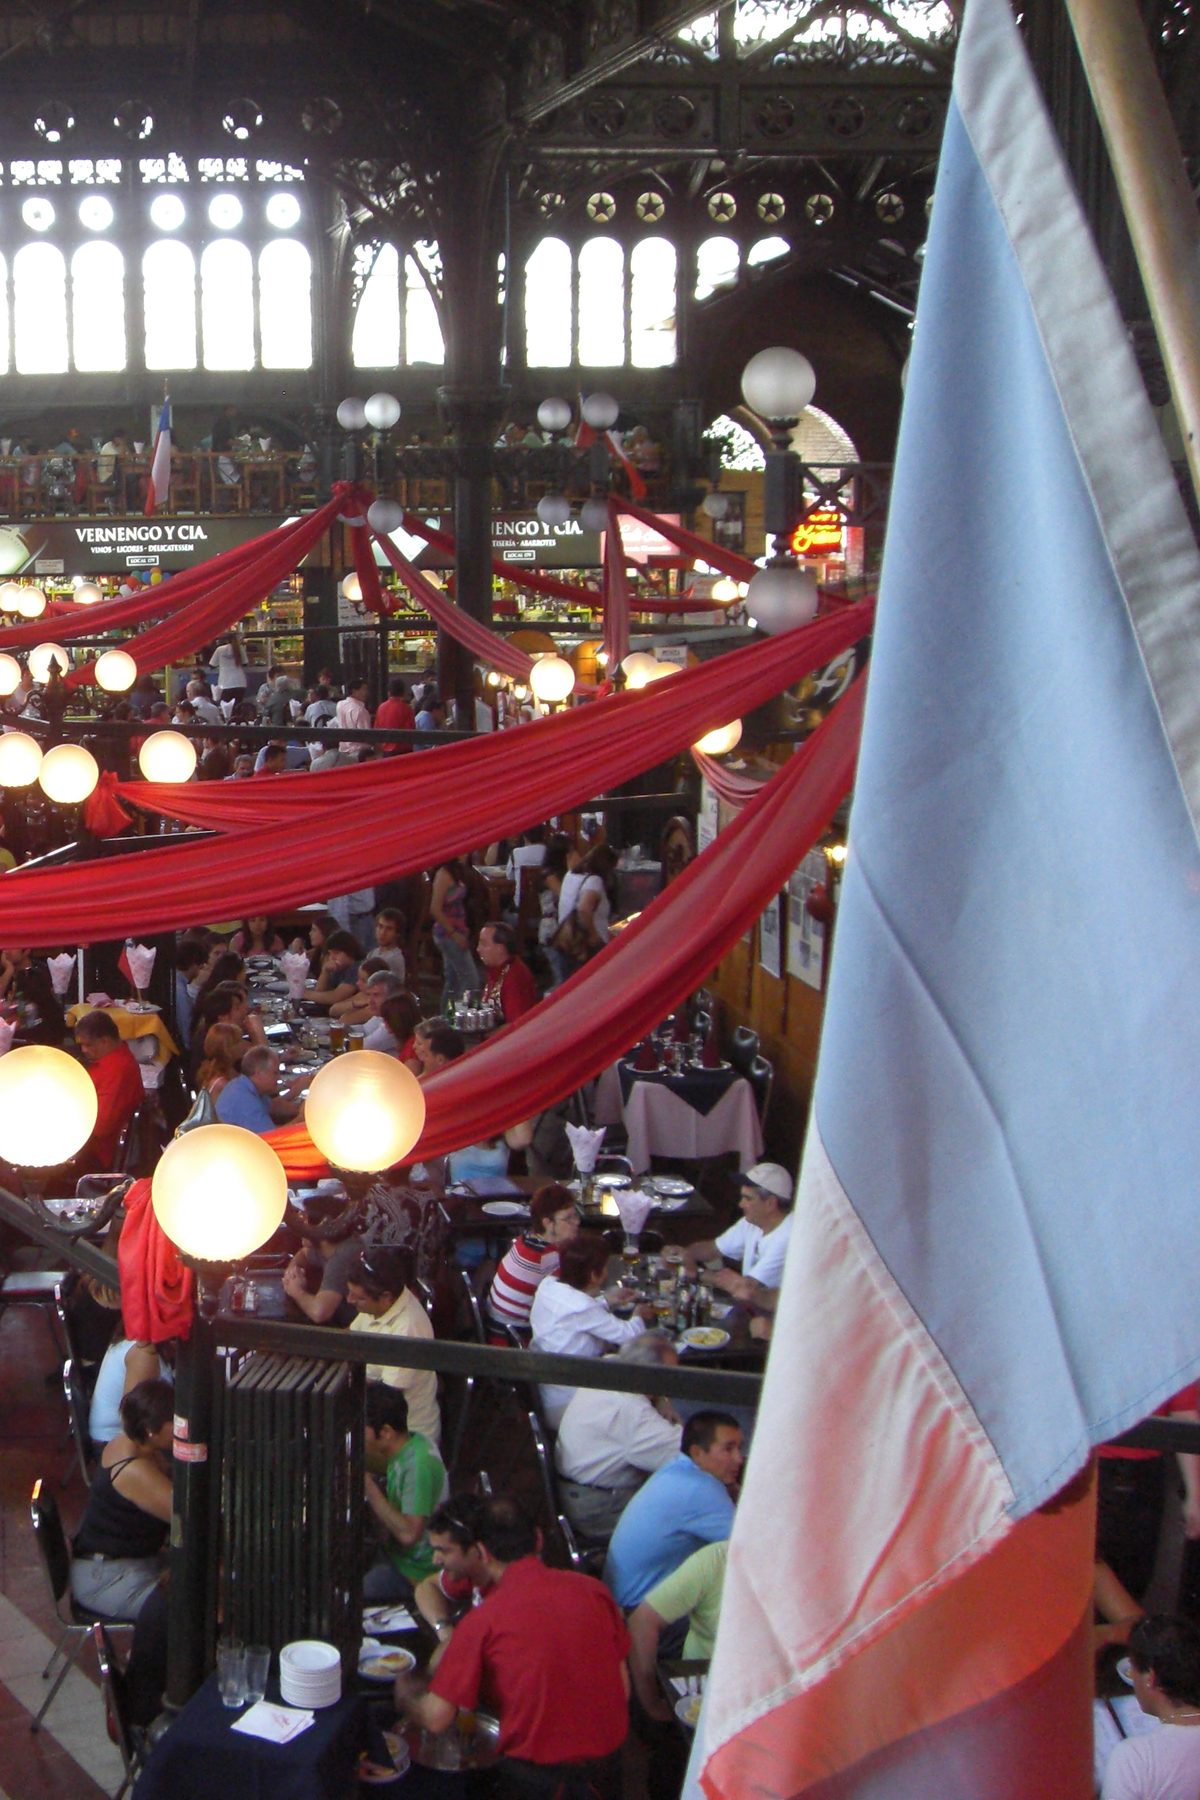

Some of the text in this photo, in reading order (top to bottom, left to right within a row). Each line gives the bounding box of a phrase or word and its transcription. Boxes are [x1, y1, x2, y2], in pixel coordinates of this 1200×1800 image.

[75, 525, 208, 542] VERNENGO Y CIA.
[491, 520, 539, 536] ENGO
[90, 544, 194, 554] VINOS LICORES DELICATESSEN
